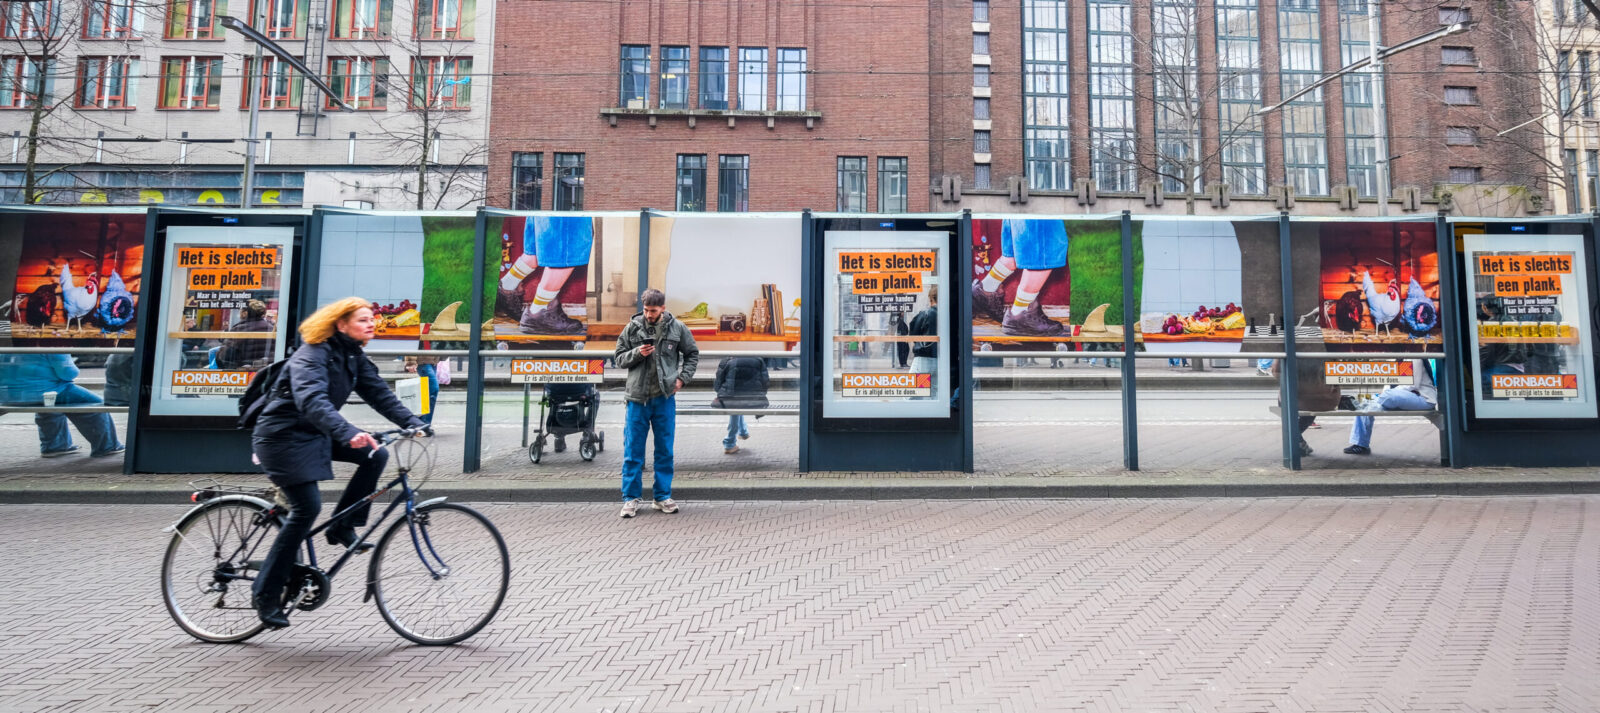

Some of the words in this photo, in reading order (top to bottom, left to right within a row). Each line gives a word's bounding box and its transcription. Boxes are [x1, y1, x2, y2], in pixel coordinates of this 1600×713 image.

[180, 250, 204, 265] Het
[209, 250, 221, 265] is
[225, 250, 273, 265] slechts
[841, 255, 864, 269] Het
[869, 254, 881, 269] is
[885, 254, 932, 269] slechts
[1482, 258, 1505, 272] Het
[1509, 258, 1521, 272] is
[1524, 257, 1570, 271] slechts
[192, 273, 216, 285] een
[220, 271, 259, 288] plank.
[855, 278, 878, 289] een
[882, 274, 921, 293] plank.
[1497, 280, 1519, 292] een
[1523, 277, 1560, 294] plank.
[513, 361, 587, 372] HORNBACH
[1327, 363, 1397, 374] HORNBACH
[174, 372, 247, 384] HORNBACH
[539, 375, 553, 383] altijd
[844, 375, 915, 386] HORNBACH
[1352, 376, 1366, 384] altijd
[1494, 376, 1561, 387] HORNBACH
[199, 386, 213, 394] altijd
[869, 389, 883, 397] altijd
[1518, 389, 1531, 397] altijd
